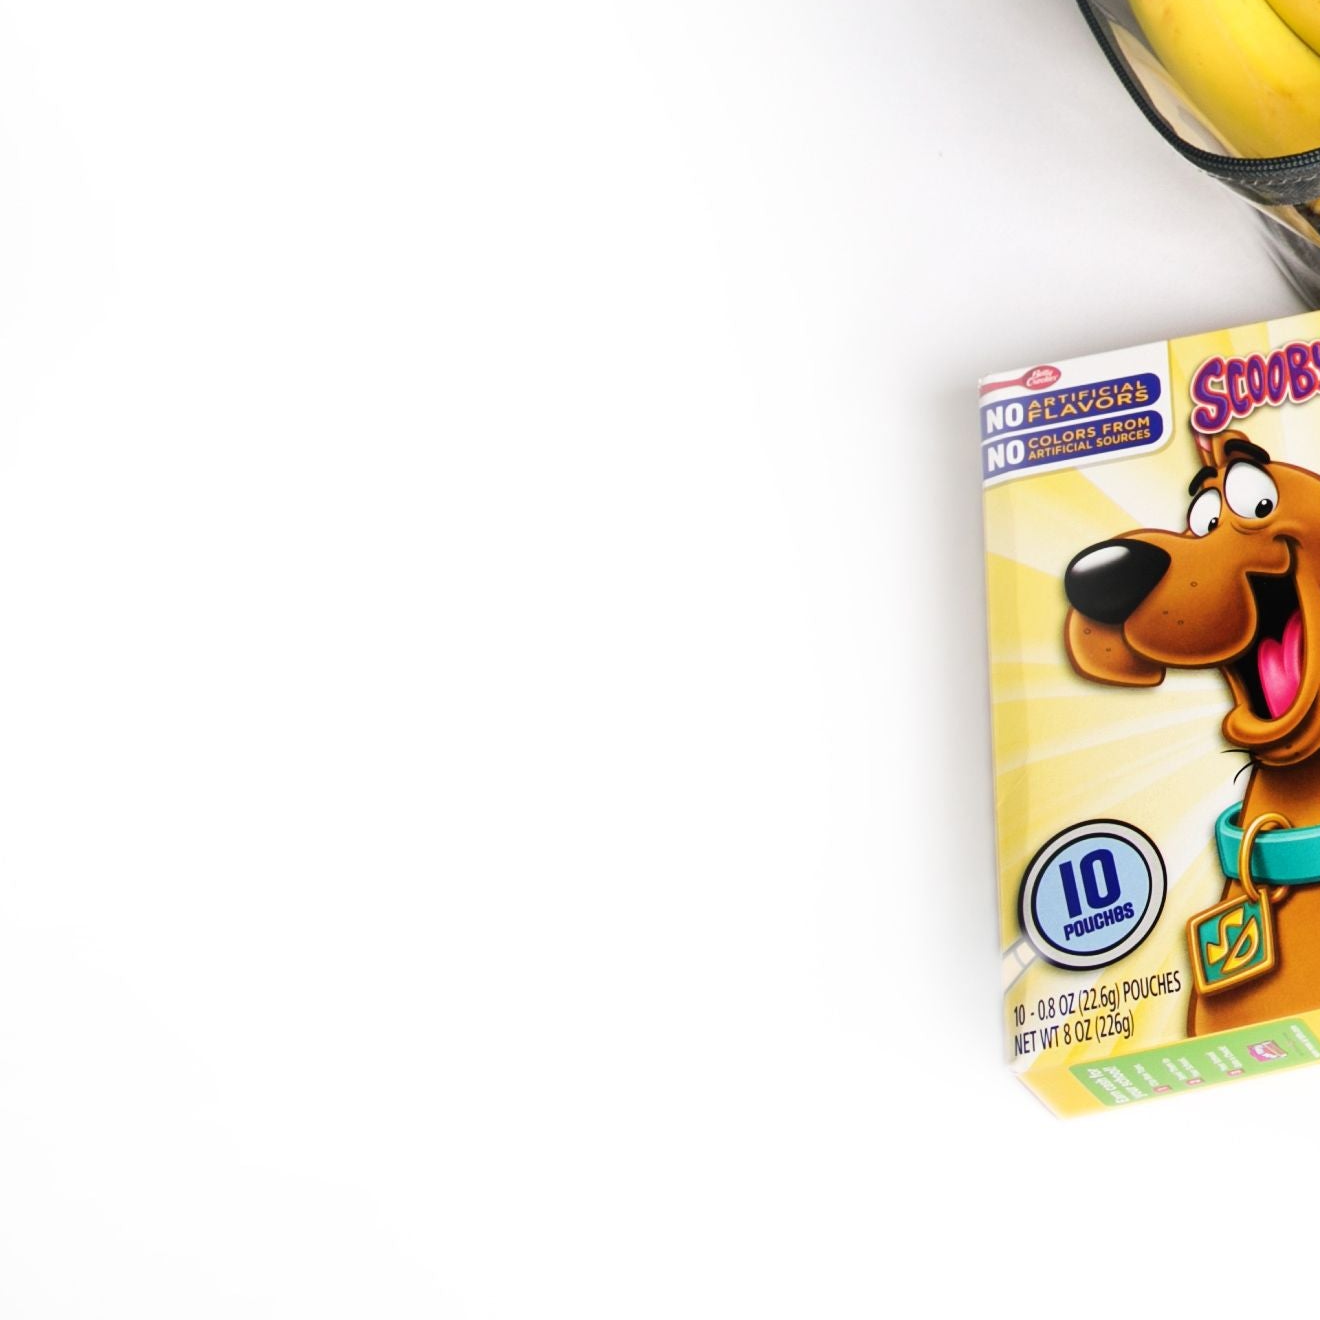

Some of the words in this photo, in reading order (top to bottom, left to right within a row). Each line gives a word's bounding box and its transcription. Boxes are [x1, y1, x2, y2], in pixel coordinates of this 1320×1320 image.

[1033, 367, 1053, 378] Betty
[1028, 381, 1147, 409] ARTIFICIAL
[1028, 389, 1149, 422] FLAVORS
[987, 403, 1023, 433] NO
[1028, 427, 1095, 449] COLORS
[1102, 417, 1150, 434] FROM
[988, 440, 1025, 472] NO
[1028, 442, 1092, 460] ARTIFICIAL
[1097, 429, 1150, 447] SOURCES
[1059, 849, 1121, 919] 10
[1014, 1004, 1025, 1027] 10
[1038, 997, 1055, 1020] 0.8
[1059, 993, 1075, 1016] OZ
[1079, 982, 1119, 1016] (22.6g)
[1123, 971, 1181, 1002] POUCHES
[1015, 1031, 1036, 1056] NET
[1040, 1025, 1059, 1049] WT
[1064, 1024, 1072, 1044] 8
[1075, 1019, 1092, 1042] OZ
[1096, 1009, 1134, 1043] (226g)
